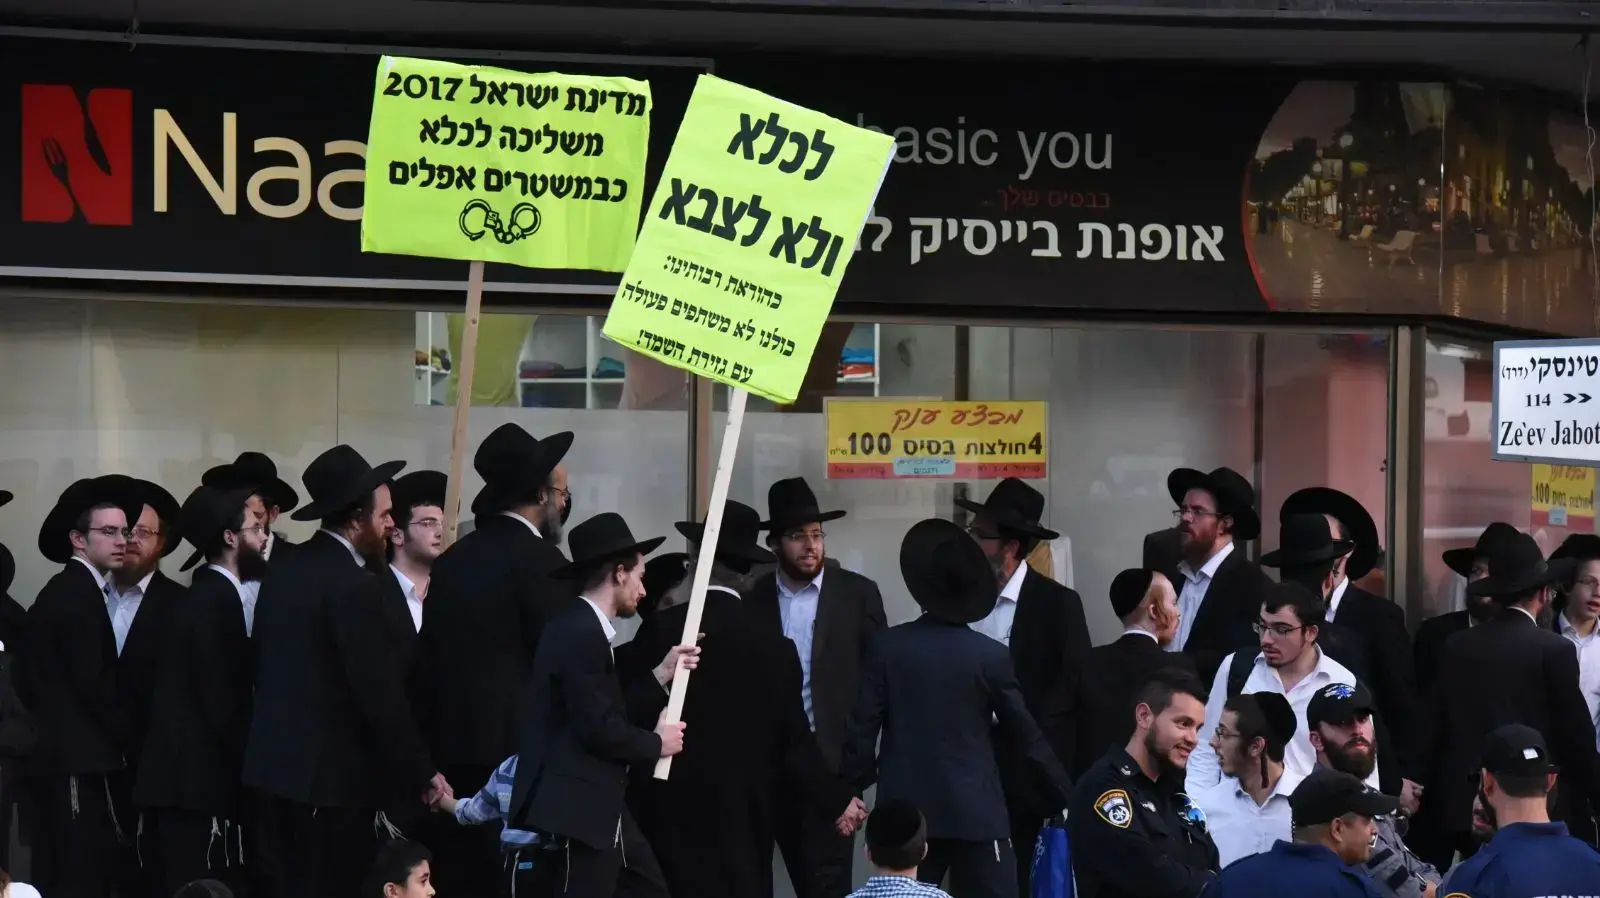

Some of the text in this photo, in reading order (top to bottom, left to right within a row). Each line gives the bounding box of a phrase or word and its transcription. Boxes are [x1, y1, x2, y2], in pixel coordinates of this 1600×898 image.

[382, 72, 647, 116] מדינת ישראל 2017
[419, 114, 604, 156] משליכה לכלא
[726, 112, 835, 181] לכלא
[1017, 130, 1113, 180] you
[388, 156, 628, 203] כבמשטרים אפלים
[658, 177, 844, 277] ולא לצבא
[854, 205, 1225, 265] אופנת בייסיק ל
[663, 255, 783, 310] כהוראת רבותינו:
[621, 280, 796, 357] כולנו לא משתפים פעולה
[636, 329, 754, 384] עם גזירת השמד!
[1501, 364, 1529, 381] (דרך)
[890, 405, 1024, 434] מבצע ענק
[1524, 393, 1552, 408] 114
[847, 432, 892, 456] 100
[903, 439, 956, 456] בסיס
[1551, 419, 1600, 446] Jabot
